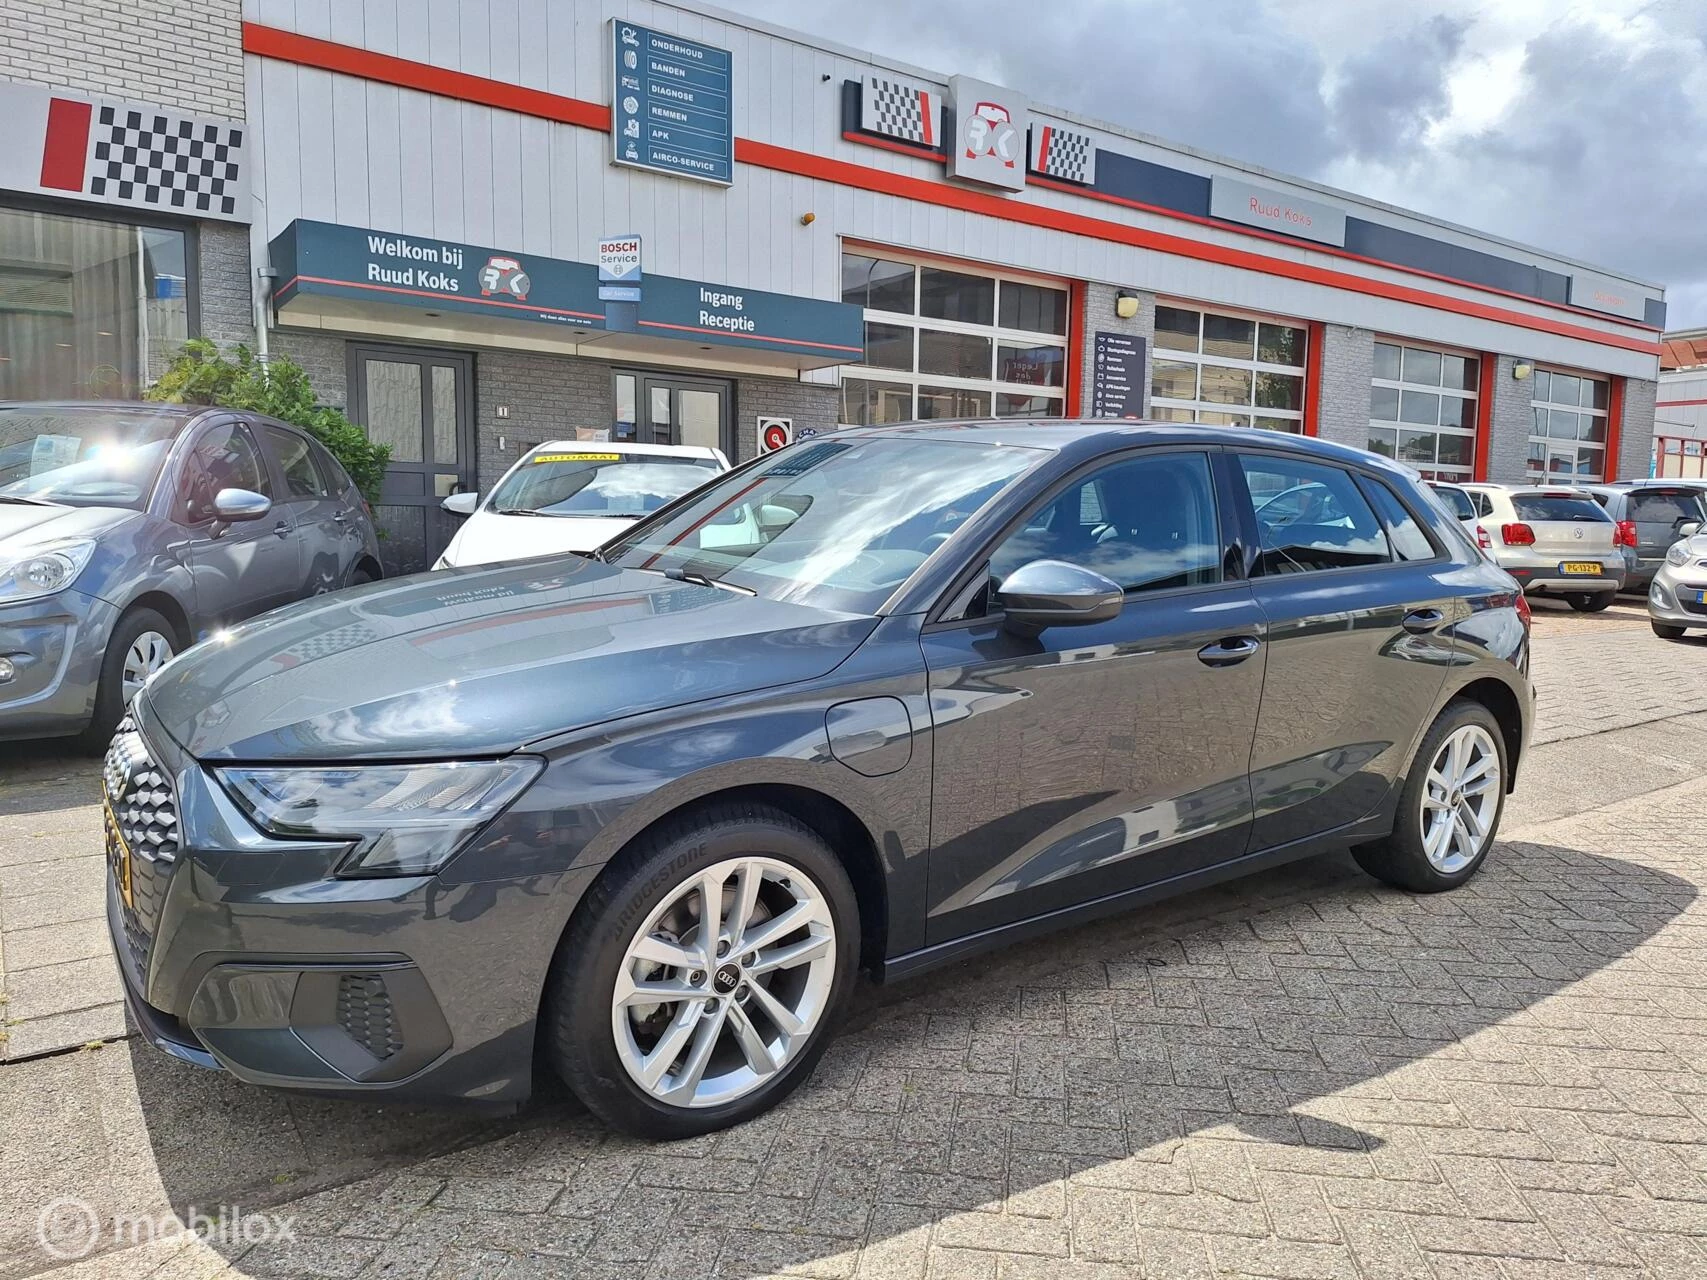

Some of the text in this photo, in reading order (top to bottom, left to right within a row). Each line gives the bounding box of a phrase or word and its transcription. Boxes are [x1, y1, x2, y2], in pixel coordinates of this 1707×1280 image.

[651, 39, 703, 59] ONDERHOUD
[651, 62, 686, 77] BANDEN
[651, 85, 694, 102] DIAGNOSE
[652, 107, 688, 122] REMMEN
[652, 130, 670, 140] APK
[652, 152, 715, 171] AIRCO-SERVICE
[1250, 197, 1280, 217] Ruud
[367, 235, 463, 270] Welkom bij
[601, 242, 637, 253] BOSCH
[601, 254, 637, 263] Service
[367, 263, 459, 292] Ruud Koks
[700, 287, 743, 310] Ingang
[700, 310, 755, 332] Receptie
